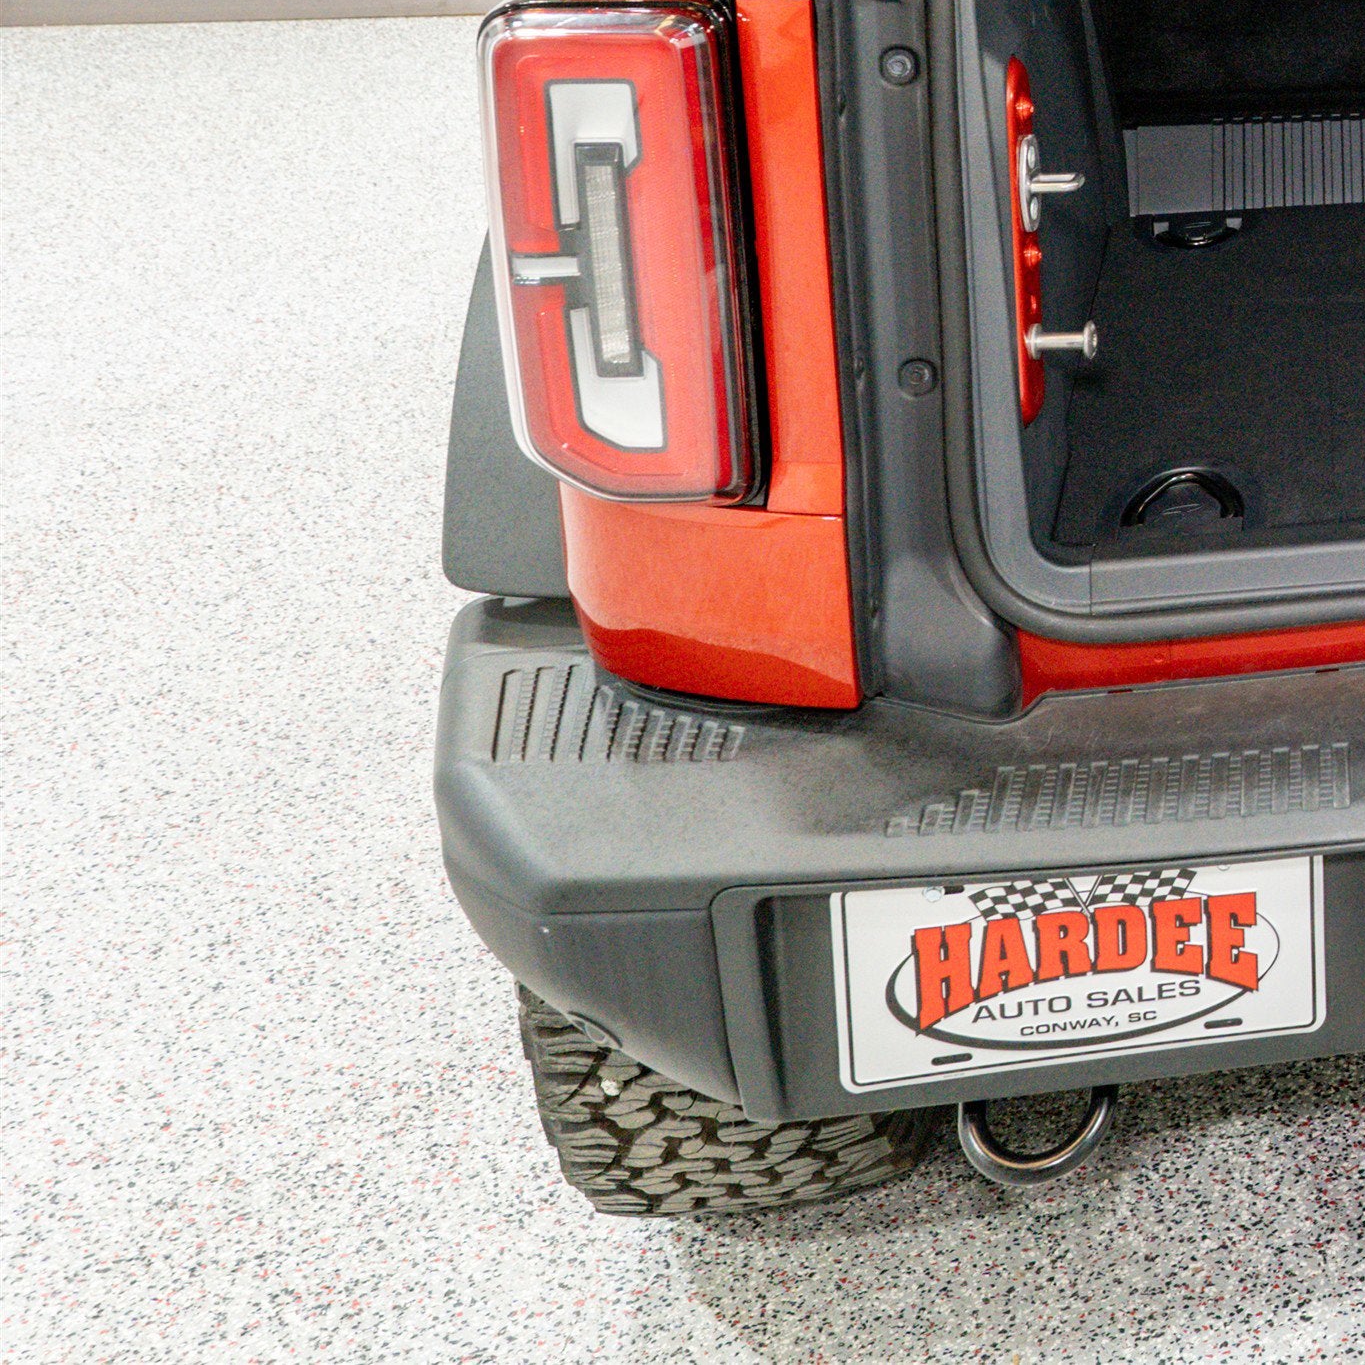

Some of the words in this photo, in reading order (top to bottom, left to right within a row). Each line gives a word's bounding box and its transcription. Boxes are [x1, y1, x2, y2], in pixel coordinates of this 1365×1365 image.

[912, 891, 1259, 1033] HARDEE
[972, 996, 1072, 1023] AUTO
[1086, 979, 1201, 1009] SALES
[1020, 1015, 1119, 1036] CONWAY,
[1128, 1010, 1158, 1022] SC
